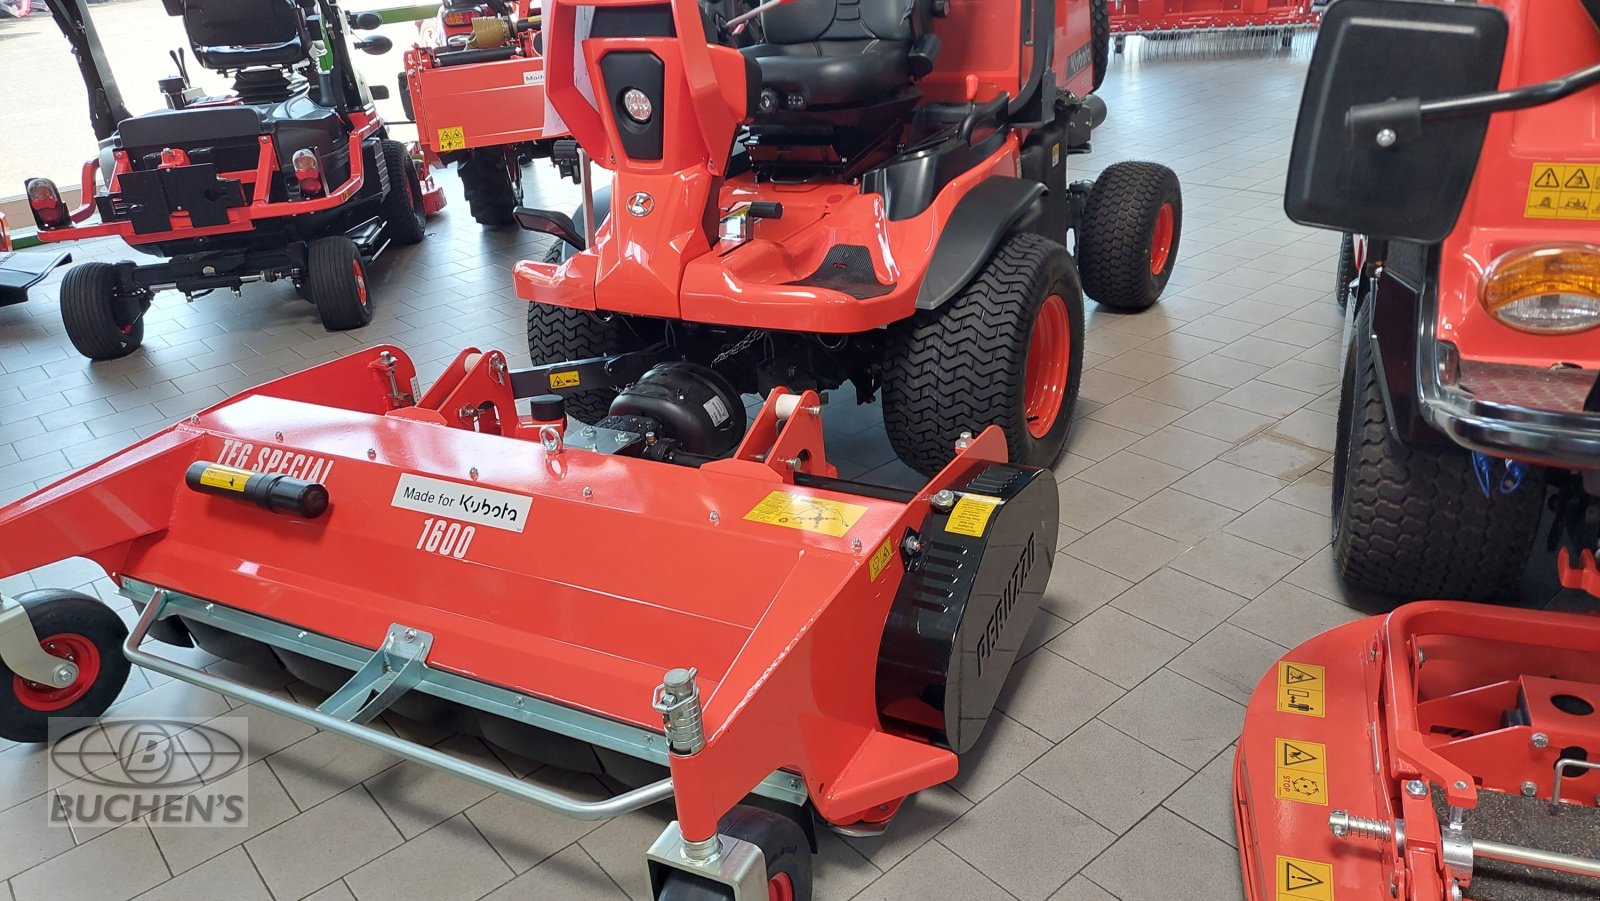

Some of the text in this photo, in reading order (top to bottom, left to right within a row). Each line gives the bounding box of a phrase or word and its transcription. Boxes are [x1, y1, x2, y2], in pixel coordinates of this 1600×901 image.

[403, 486, 518, 522] Made for Kubota
[416, 517, 476, 559] 1600
[1282, 775, 1291, 793] STOP
